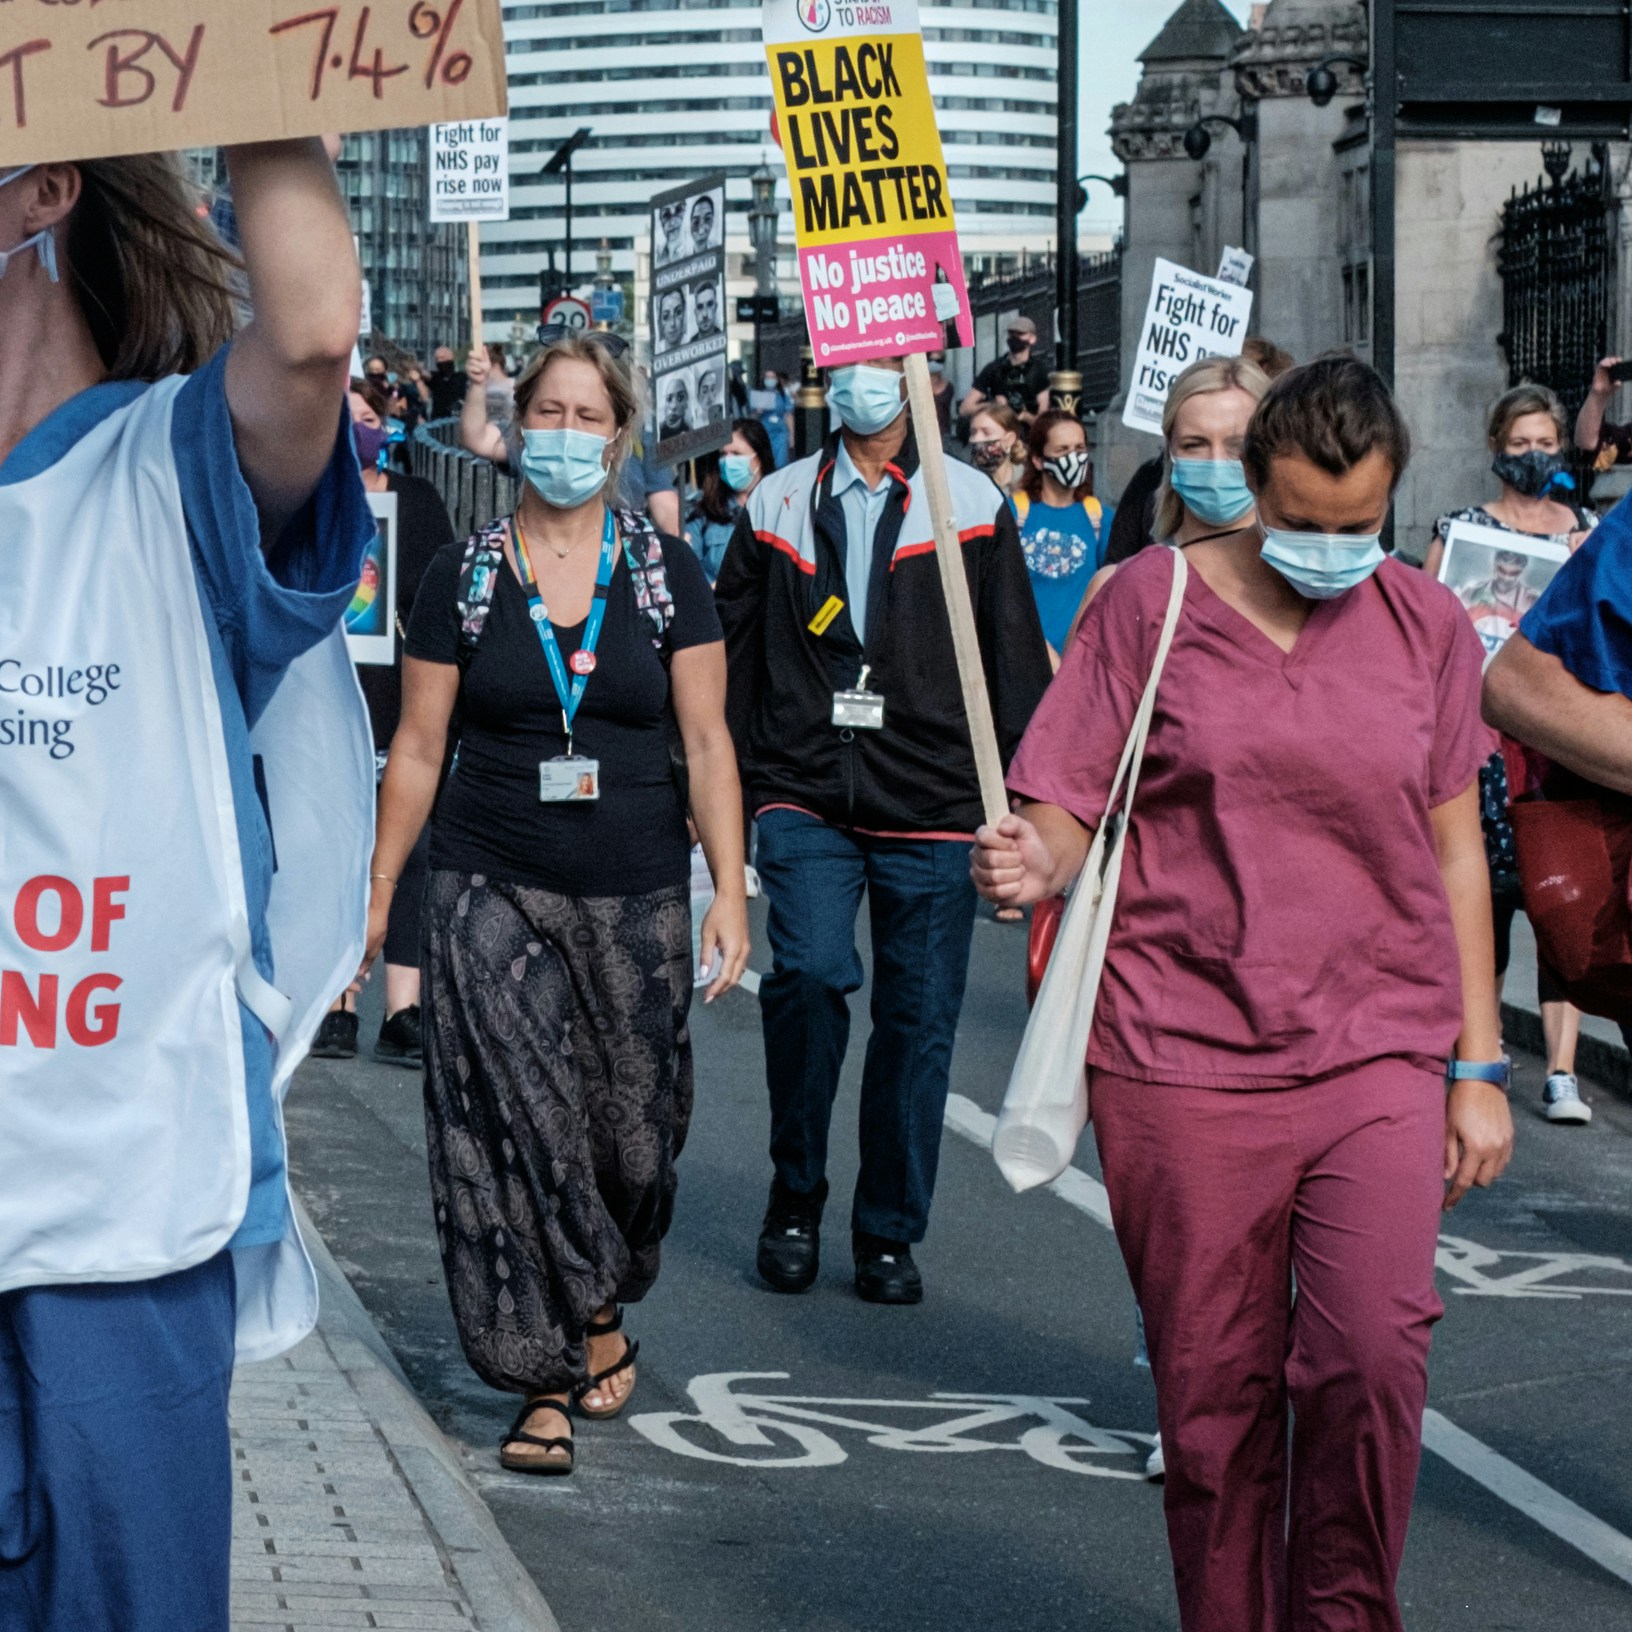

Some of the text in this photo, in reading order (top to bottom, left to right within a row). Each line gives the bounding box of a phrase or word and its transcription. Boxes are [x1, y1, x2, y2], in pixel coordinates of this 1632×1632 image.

[836, 5, 892, 26] TO RACISM
[88, 24, 206, 113] BY
[776, 42, 902, 107] BLACK
[436, 122, 502, 148] Fight for
[787, 104, 900, 170] LIVES
[436, 150, 500, 174] NHS pay
[436, 174, 502, 194] rise now
[799, 164, 948, 233] MATTER
[656, 255, 717, 289] UNDERPAID
[806, 243, 926, 295] No justice
[813, 289, 926, 334] No peace
[1155, 283, 1239, 338] Fight for
[654, 336, 727, 370] OVERWORKED
[1146, 322, 1191, 362] NHS
[12, 873, 131, 953] OF
